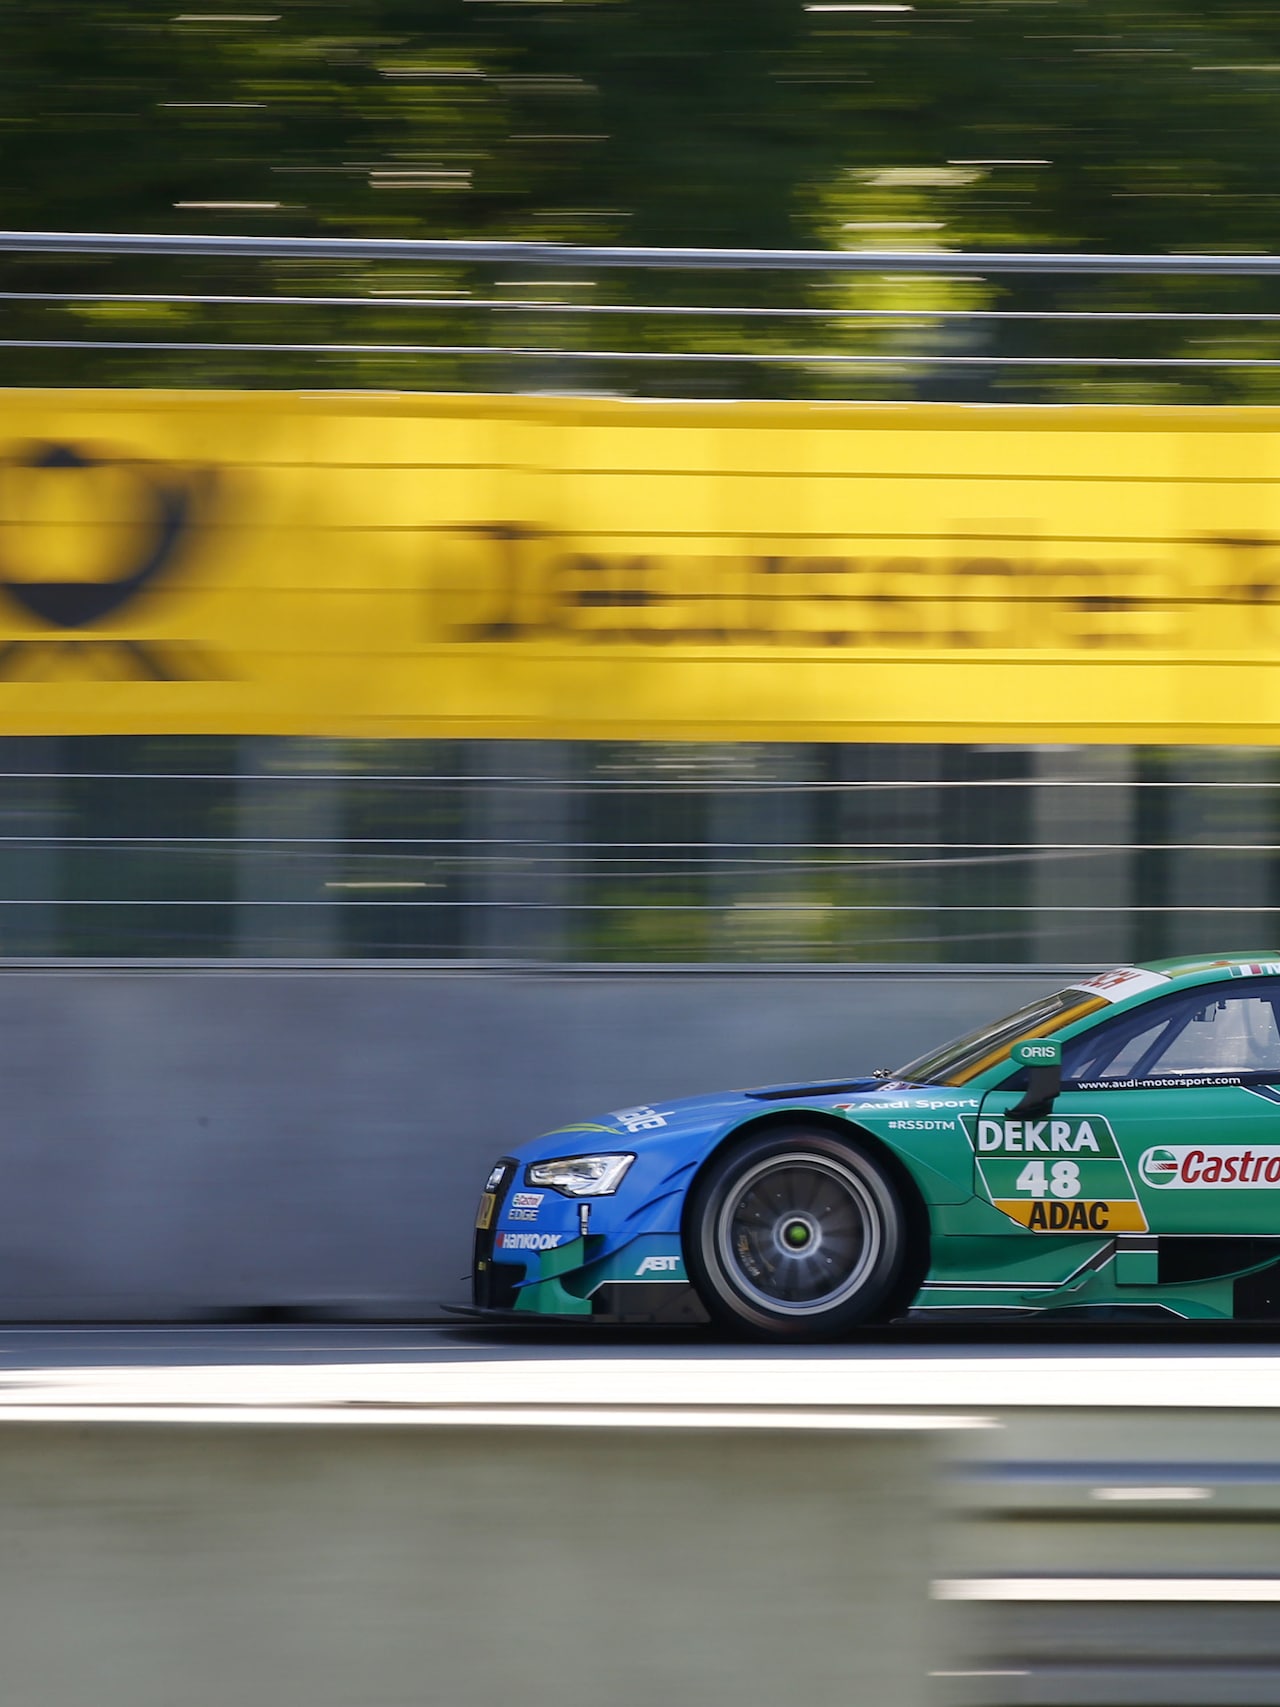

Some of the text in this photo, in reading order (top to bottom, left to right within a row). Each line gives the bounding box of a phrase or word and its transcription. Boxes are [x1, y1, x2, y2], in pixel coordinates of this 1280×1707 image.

[1020, 1046, 1056, 1058] ORIS
[1077, 1075, 1241, 1090] www.audi-motorsport.com
[858, 1099, 979, 1111] Audi Sport
[978, 1120, 1100, 1152] DEKRA
[1016, 1160, 1081, 1198] 48
[508, 1208, 540, 1221] EDGE
[1028, 1201, 1109, 1230] ADAC
[635, 1256, 680, 1276] ABT
